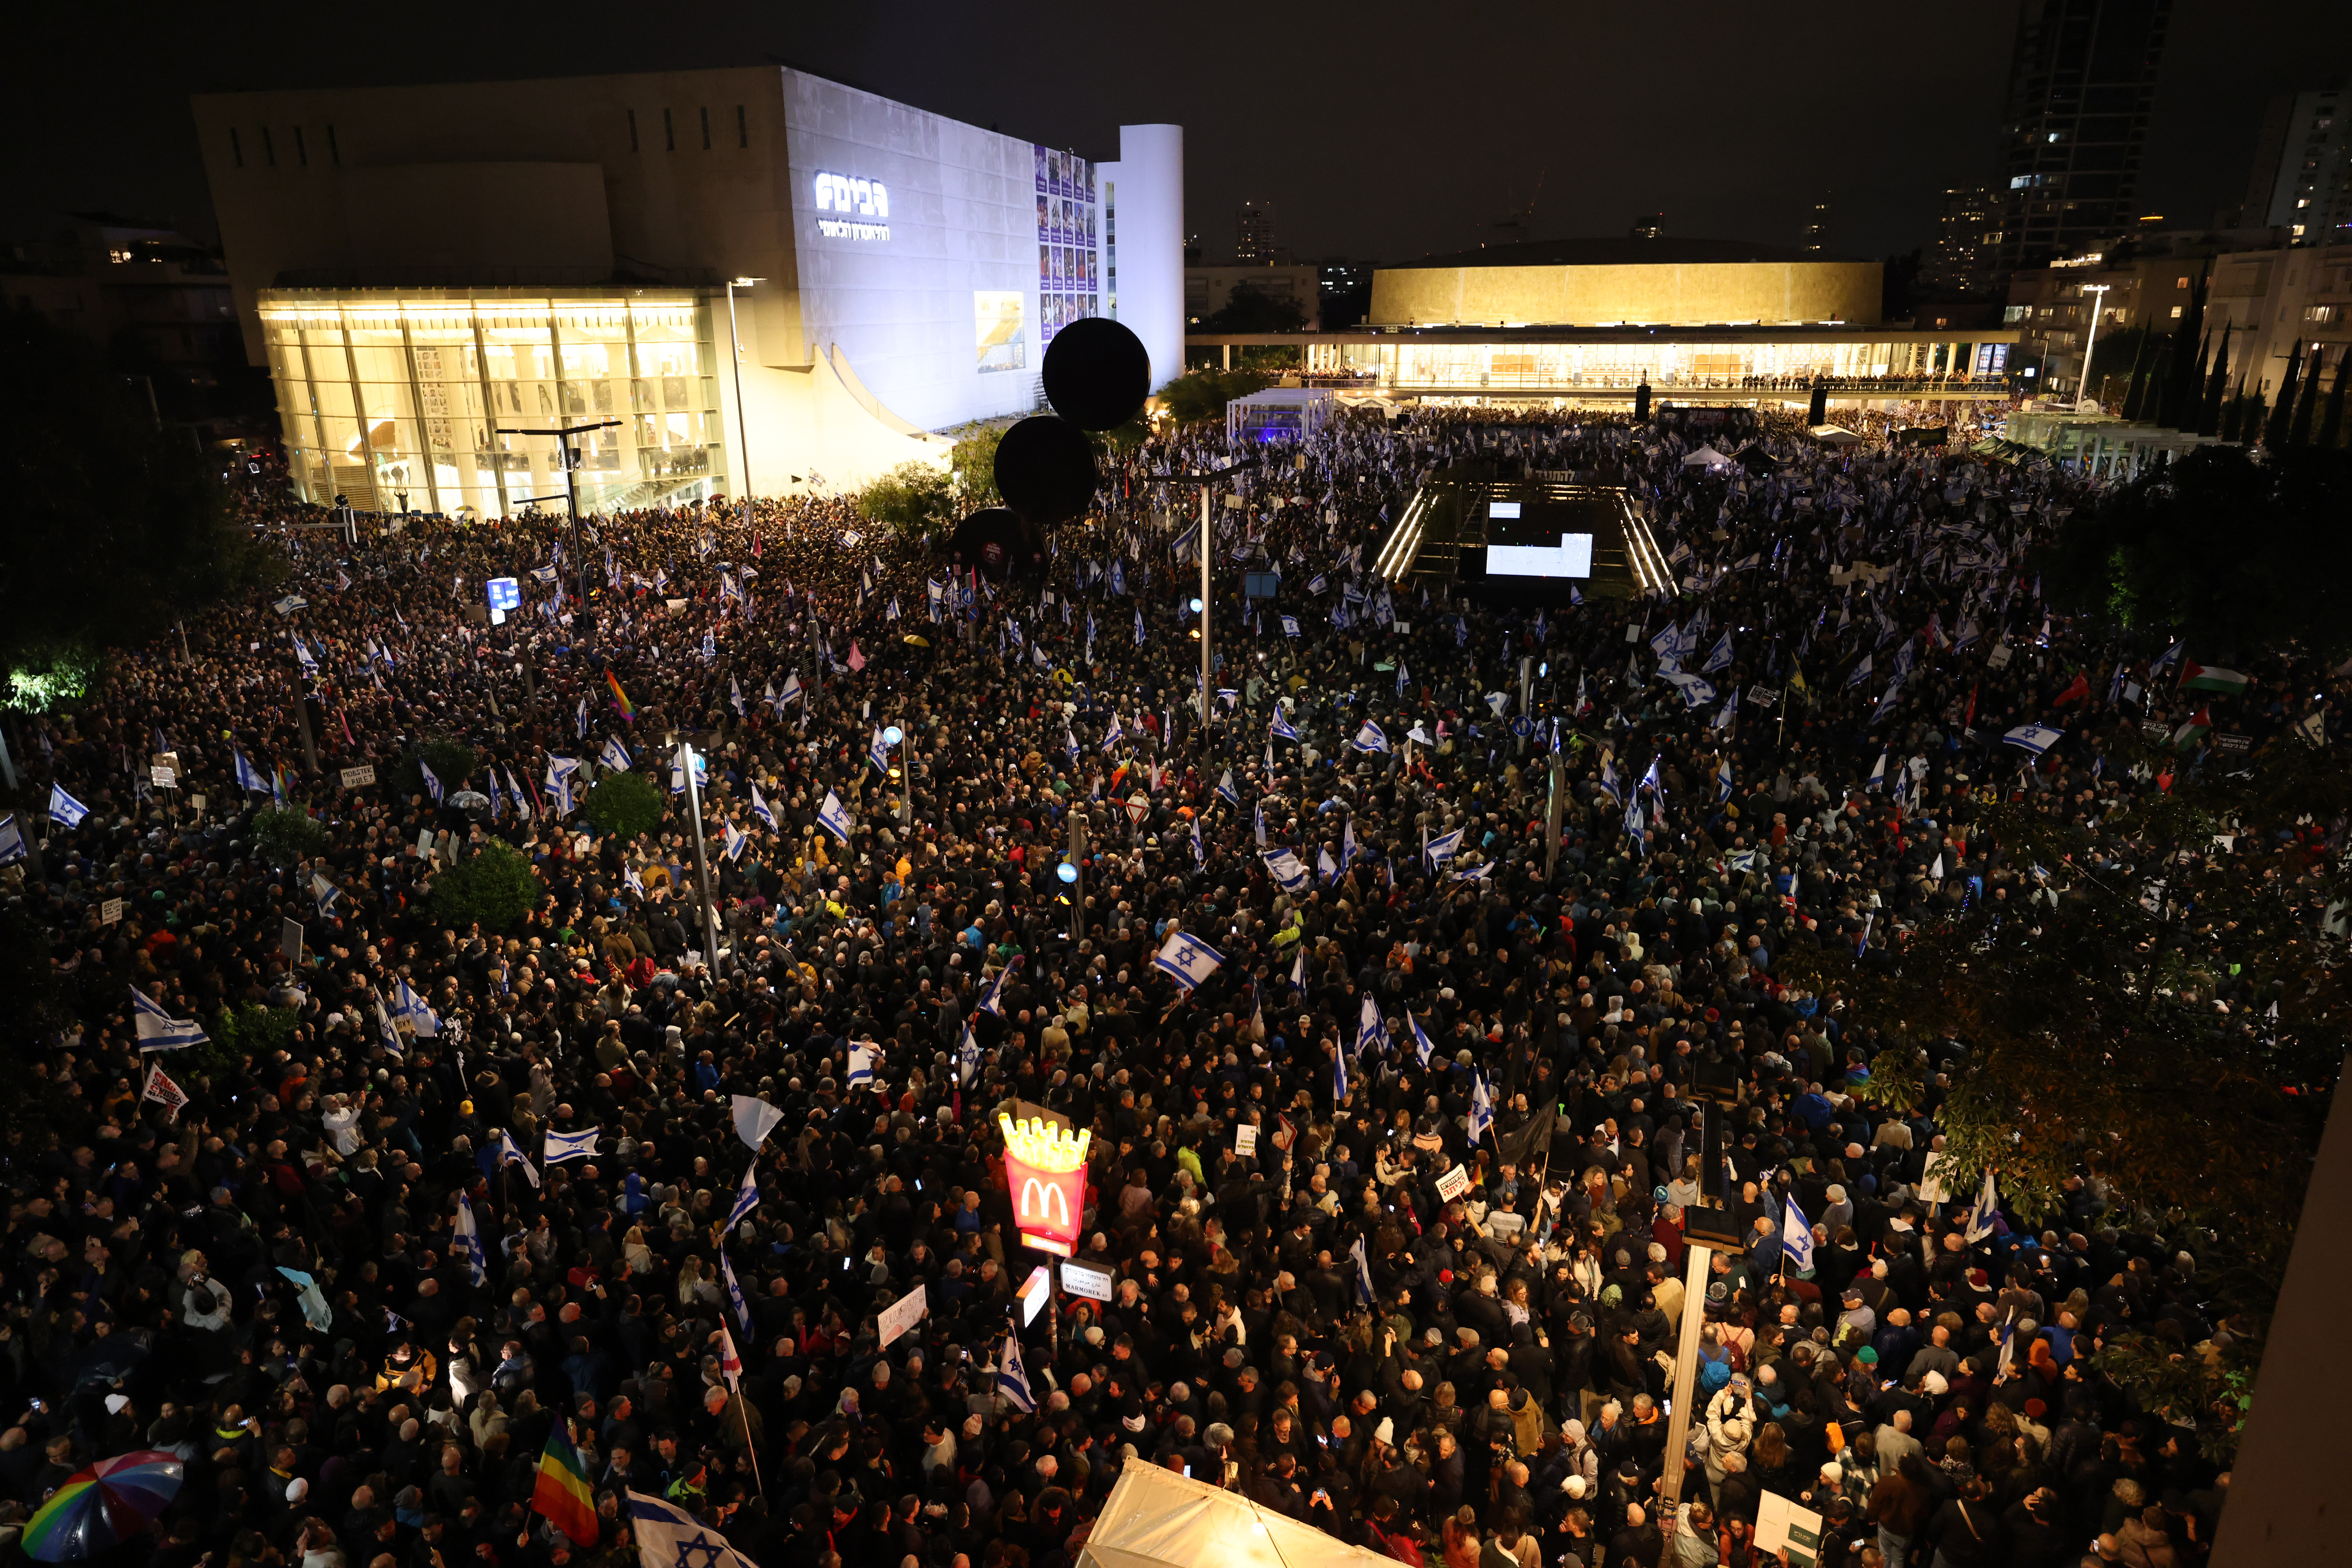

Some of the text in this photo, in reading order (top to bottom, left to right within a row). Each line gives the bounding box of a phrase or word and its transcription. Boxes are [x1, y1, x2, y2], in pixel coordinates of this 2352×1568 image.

[816, 173, 888, 217] הבימה
[818, 220, 889, 241] התיאטרון הלאומי
[343, 767, 372, 778] MOBSTER
[351, 775, 373, 785] RULE?
[1441, 1171, 1463, 1189] מושחתים
[1443, 1177, 1465, 1196] הביתה
[1065, 1267, 1084, 1276] מרמורק
[1066, 1283, 1100, 1296] MARMOREK
